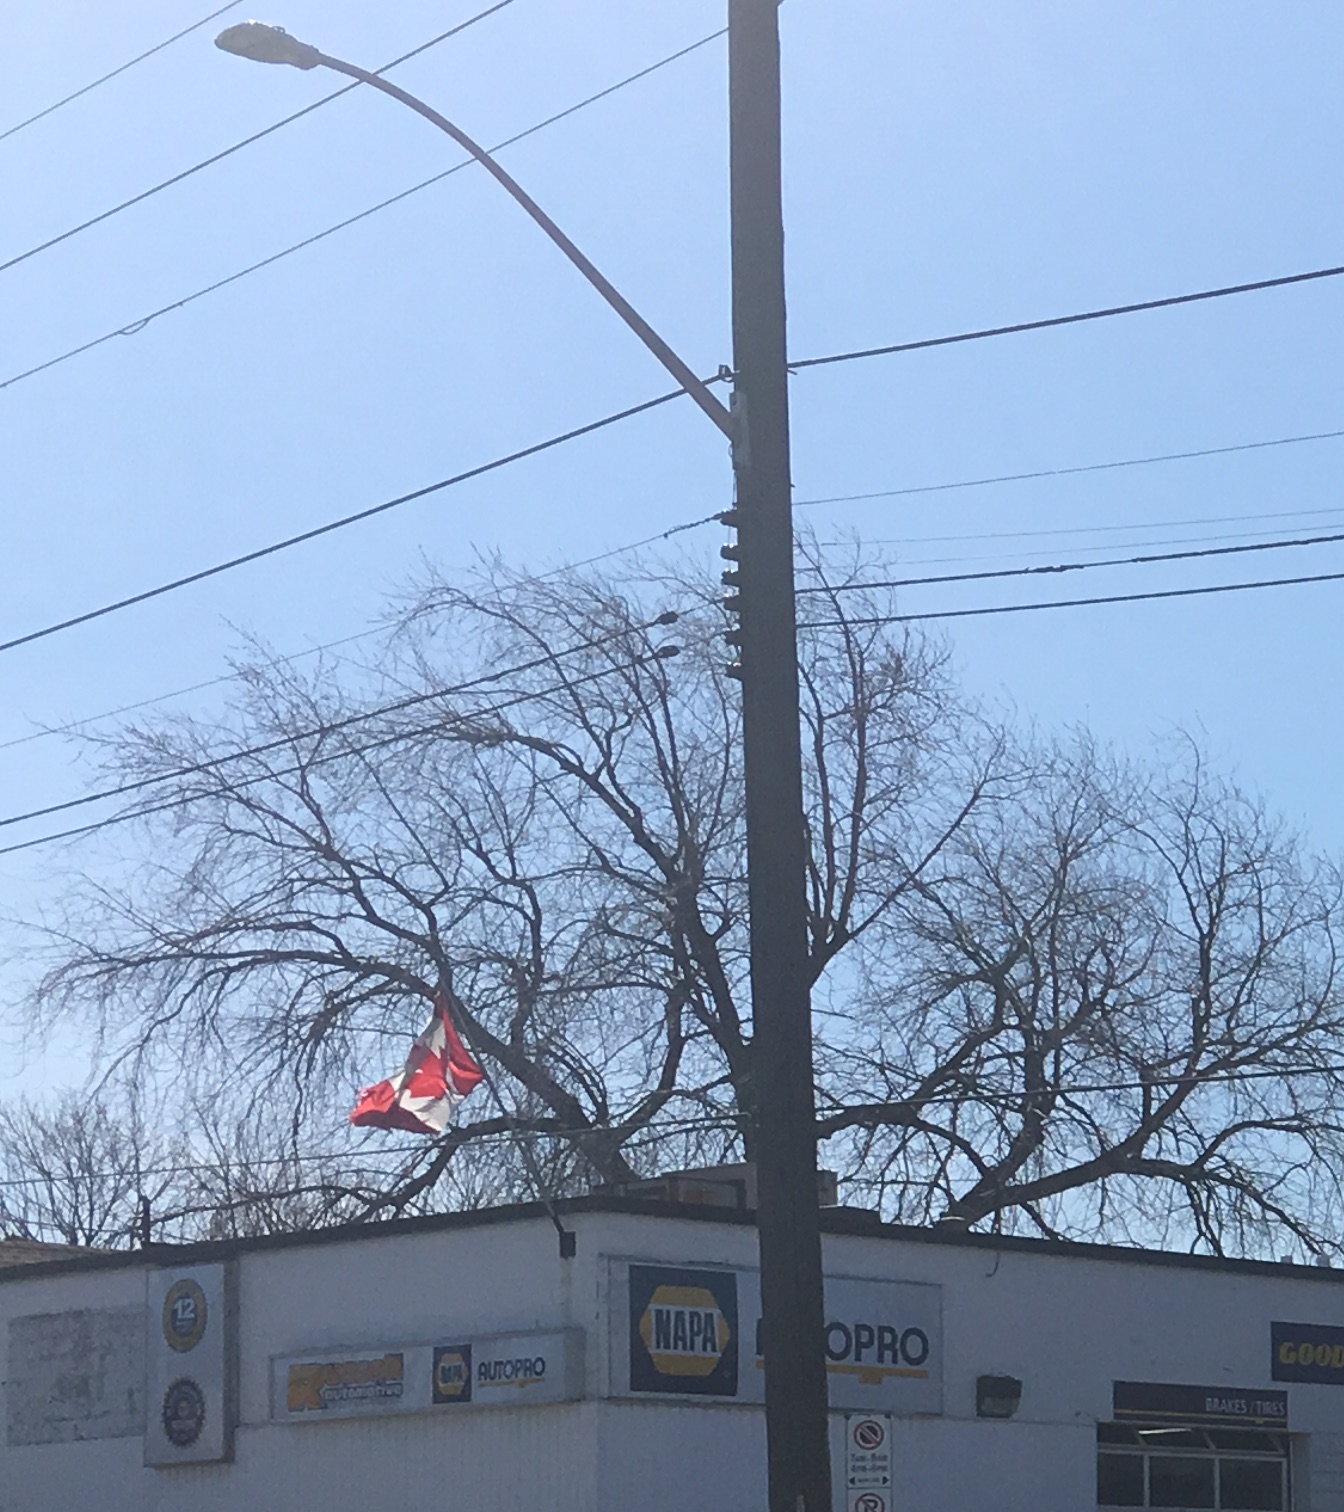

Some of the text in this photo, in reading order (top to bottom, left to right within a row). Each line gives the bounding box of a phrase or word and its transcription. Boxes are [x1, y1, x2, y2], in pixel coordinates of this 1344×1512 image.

[172, 1297, 195, 1319] 12
[655, 1307, 718, 1353] NAPA
[478, 1356, 546, 1381] AUTOPRO
[1205, 1397, 1247, 1414] BRAKES
[1256, 1401, 1285, 1416] TIRES
